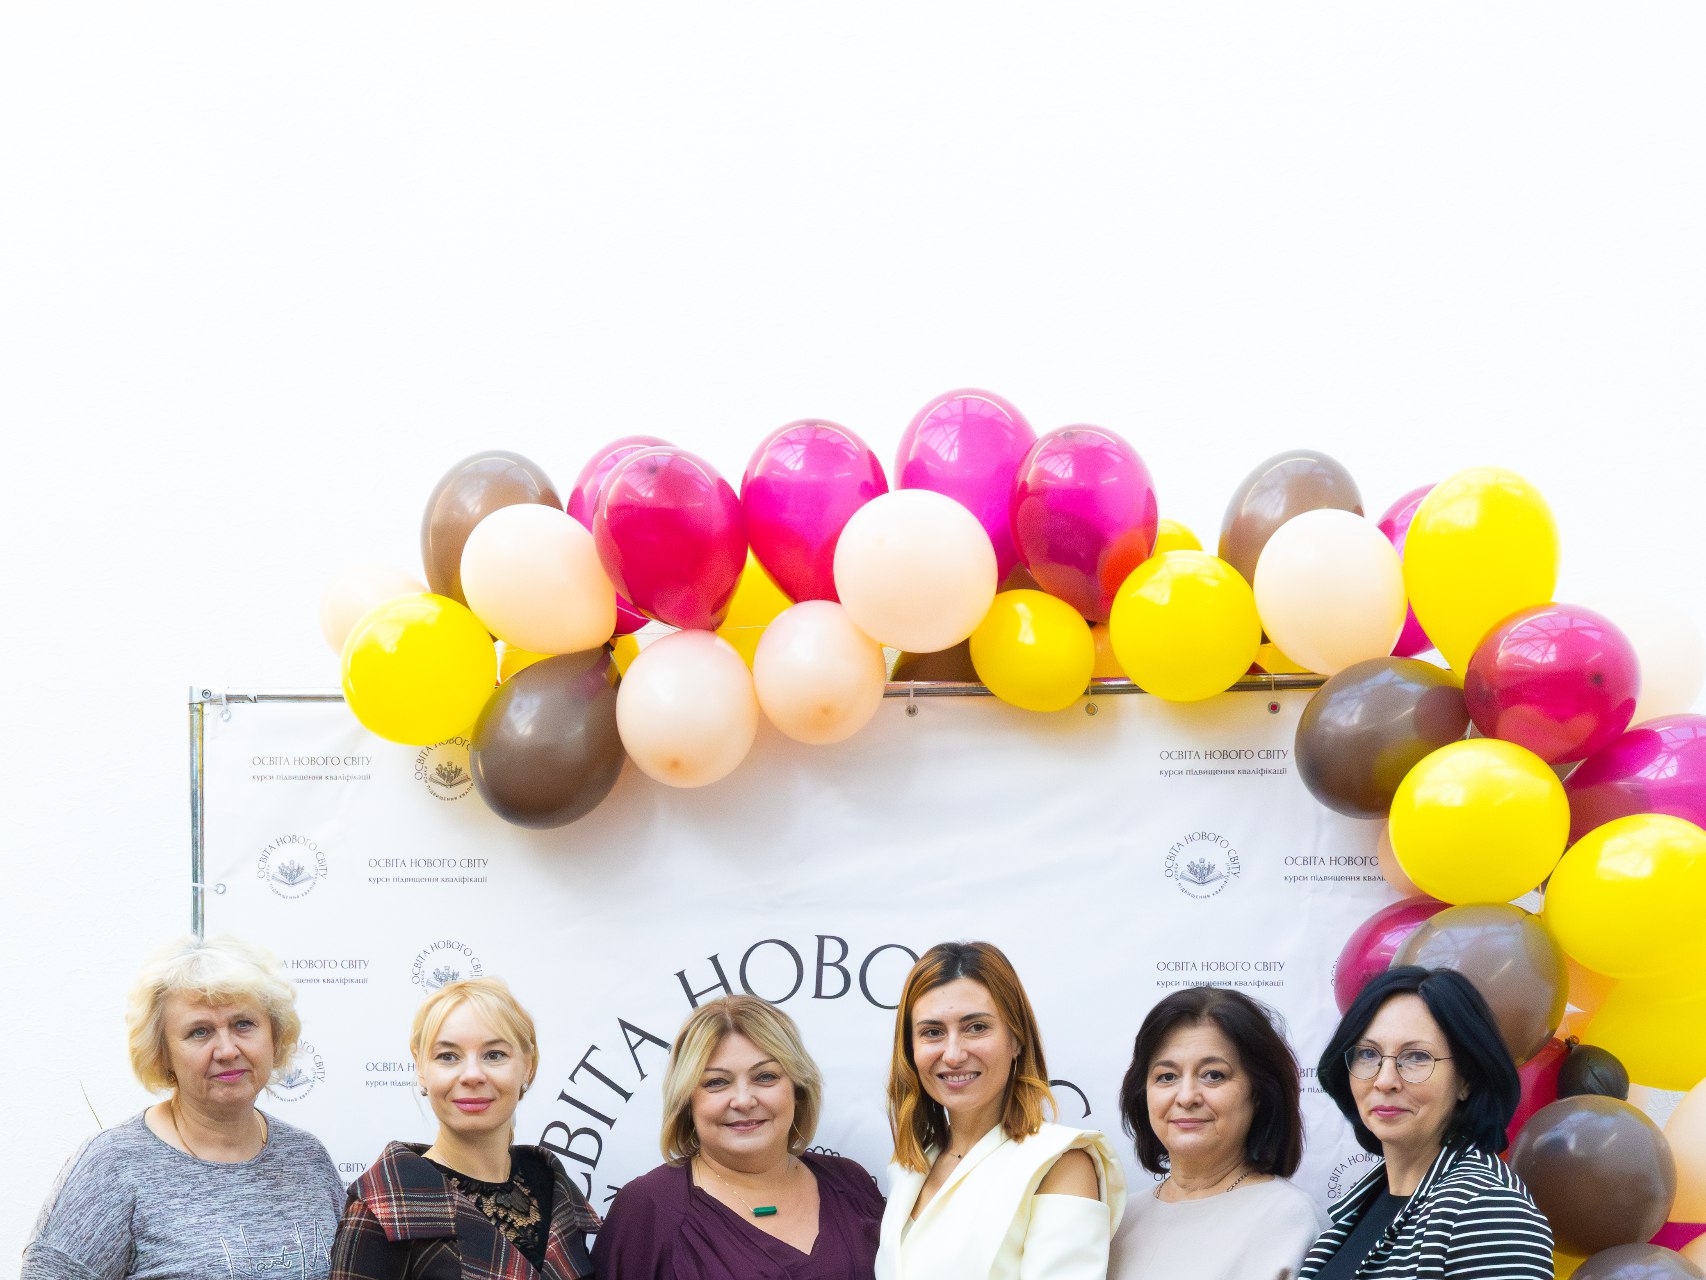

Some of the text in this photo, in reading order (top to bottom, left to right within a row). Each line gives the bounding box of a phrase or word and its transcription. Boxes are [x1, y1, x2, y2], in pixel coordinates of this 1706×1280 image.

[1159, 749, 1288, 760] ОСВІТА НОВОГО СВІТУ
[252, 756, 372, 766] ОСВІТА НОВОГО СВІТУ
[414, 746, 433, 780] ОСВІТА
[1159, 767, 1287, 777] курси підвищення кваліфікації
[252, 773, 371, 782] курси підвищення кваліфікації
[257, 834, 328, 880] ОСВІТА НОВОГО СВІТУ
[1164, 831, 1241, 879] ОСВІТА НОВОГО СВІТУ
[368, 858, 489, 868] ОСВІТА НОВОГО СВІТУ
[1284, 856, 1326, 866] ОСВІТА
[368, 875, 488, 884] курси підвищення кваліфікації
[1284, 875, 1308, 883] курси
[1310, 874, 1361, 882] підвищення
[291, 959, 338, 970] НОВОГО
[340, 959, 370, 970] СВІТУ
[411, 949, 431, 985] ОСВІТА
[430, 939, 473, 957] НОВОГО
[1156, 961, 1286, 972] ОСВІТА НОВОГО СВІТУ
[673, 934, 920, 1012] НОВО
[322, 977, 369, 985] кваліфікації
[1156, 980, 1180, 988] курси
[1234, 979, 1284, 988] кваліфікації
[313, 1054, 326, 1082] СВІТУ
[366, 1062, 404, 1072] ОСВІТА
[366, 1080, 388, 1088] курси
[338, 1162, 367, 1173] СВІТУ
[1327, 1163, 1349, 1199] ОСВІТА
